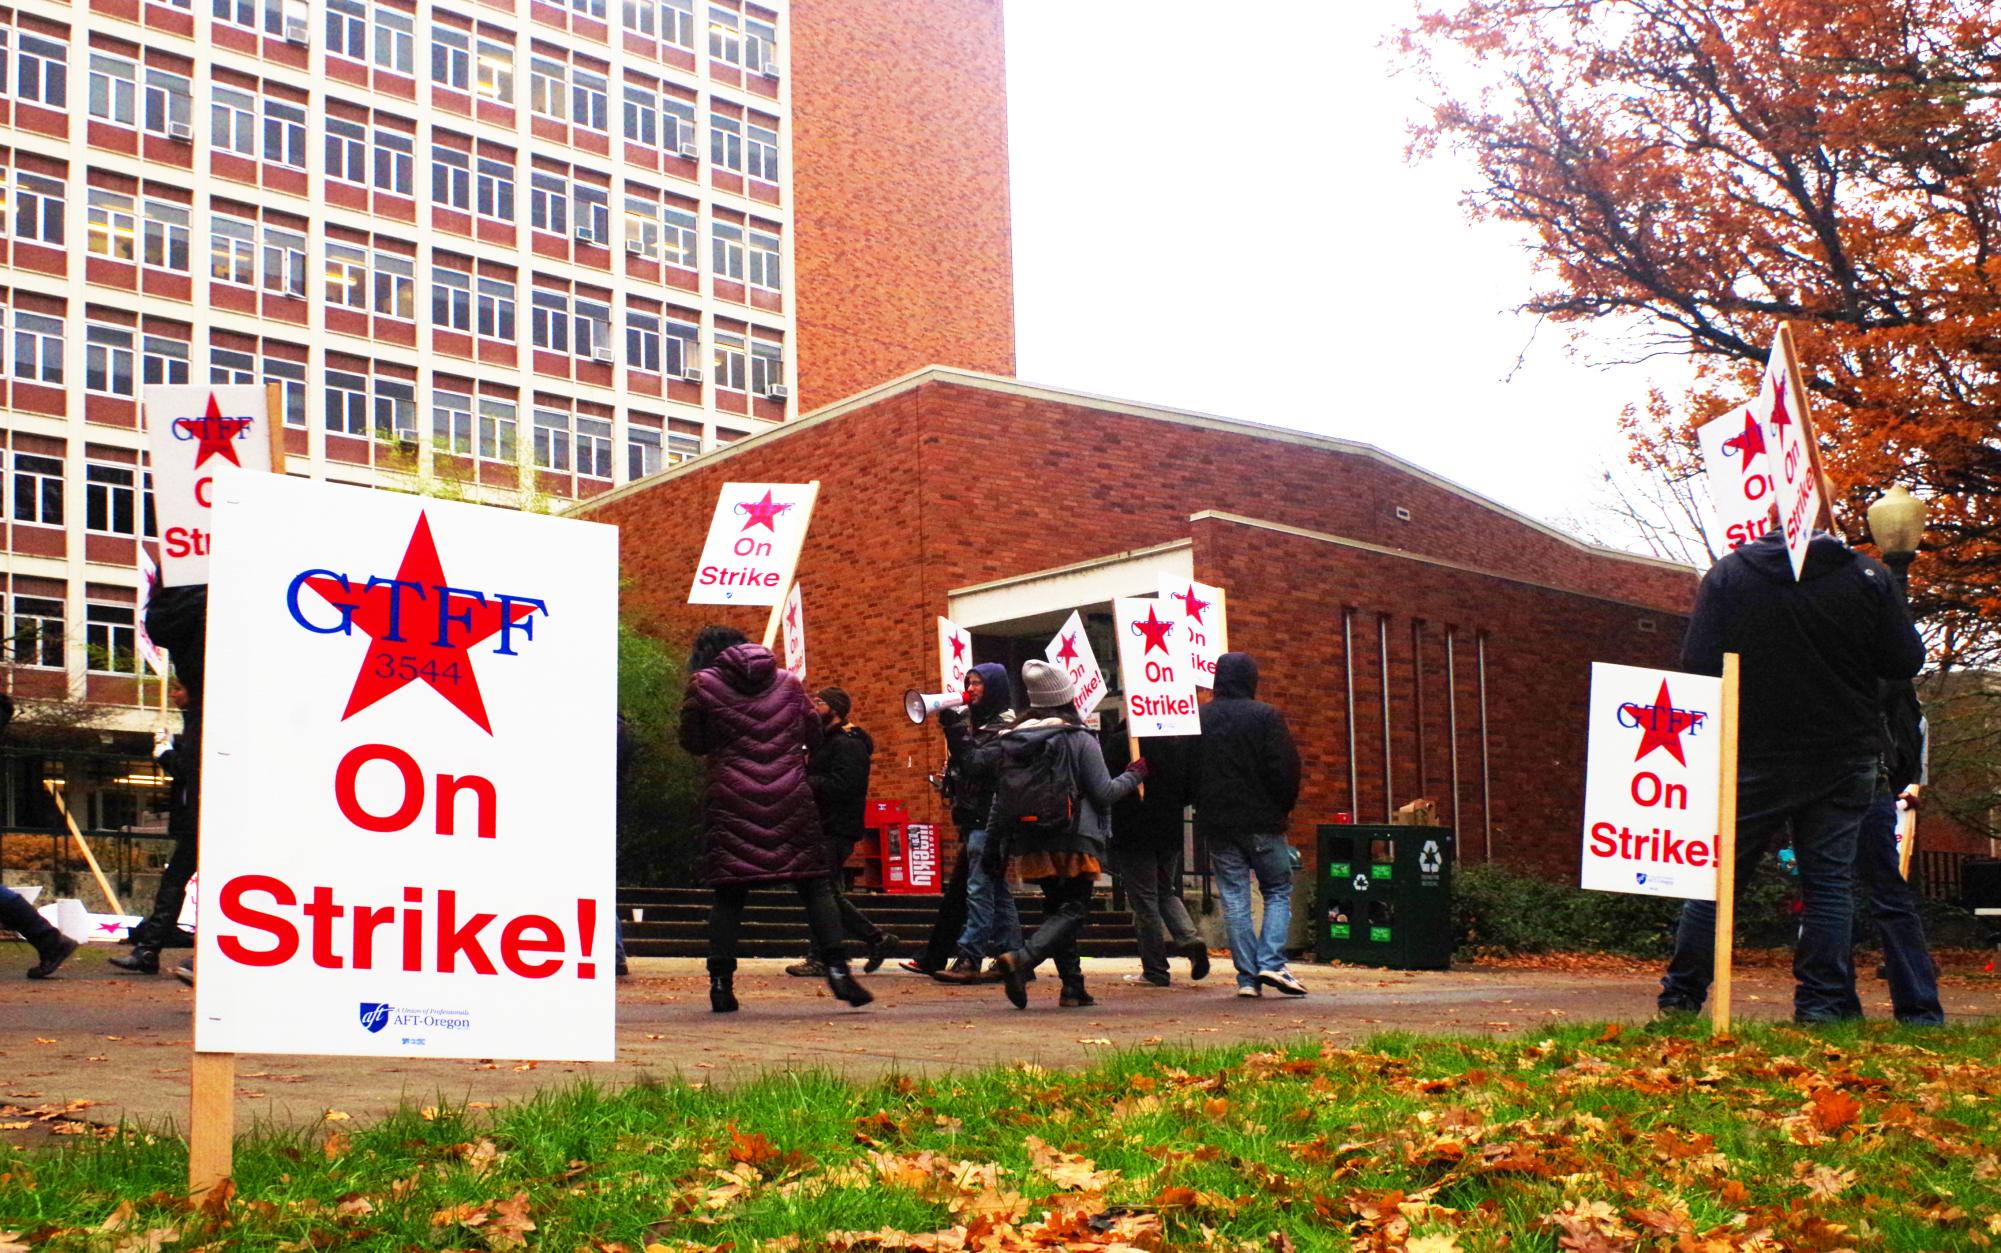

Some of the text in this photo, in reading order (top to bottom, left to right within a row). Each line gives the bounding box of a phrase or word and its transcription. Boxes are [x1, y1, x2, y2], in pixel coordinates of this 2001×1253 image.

[171, 416, 254, 441] GTFF
[1785, 439, 1800, 485] On
[734, 537, 772, 556] On
[699, 566, 780, 587] Strike
[286, 568, 549, 656] GTFF
[375, 652, 462, 686] 3544
[1145, 661, 1174, 683] On
[1073, 669, 1102, 710] trike!
[1131, 694, 1196, 717] Strike!
[1617, 702, 1709, 736] GTFF
[335, 743, 497, 839] On
[1631, 771, 1688, 810] On
[1590, 822, 1721, 869] Strike!
[217, 874, 596, 980] Strike!
[394, 1014, 470, 1030] AFT-Oregon
